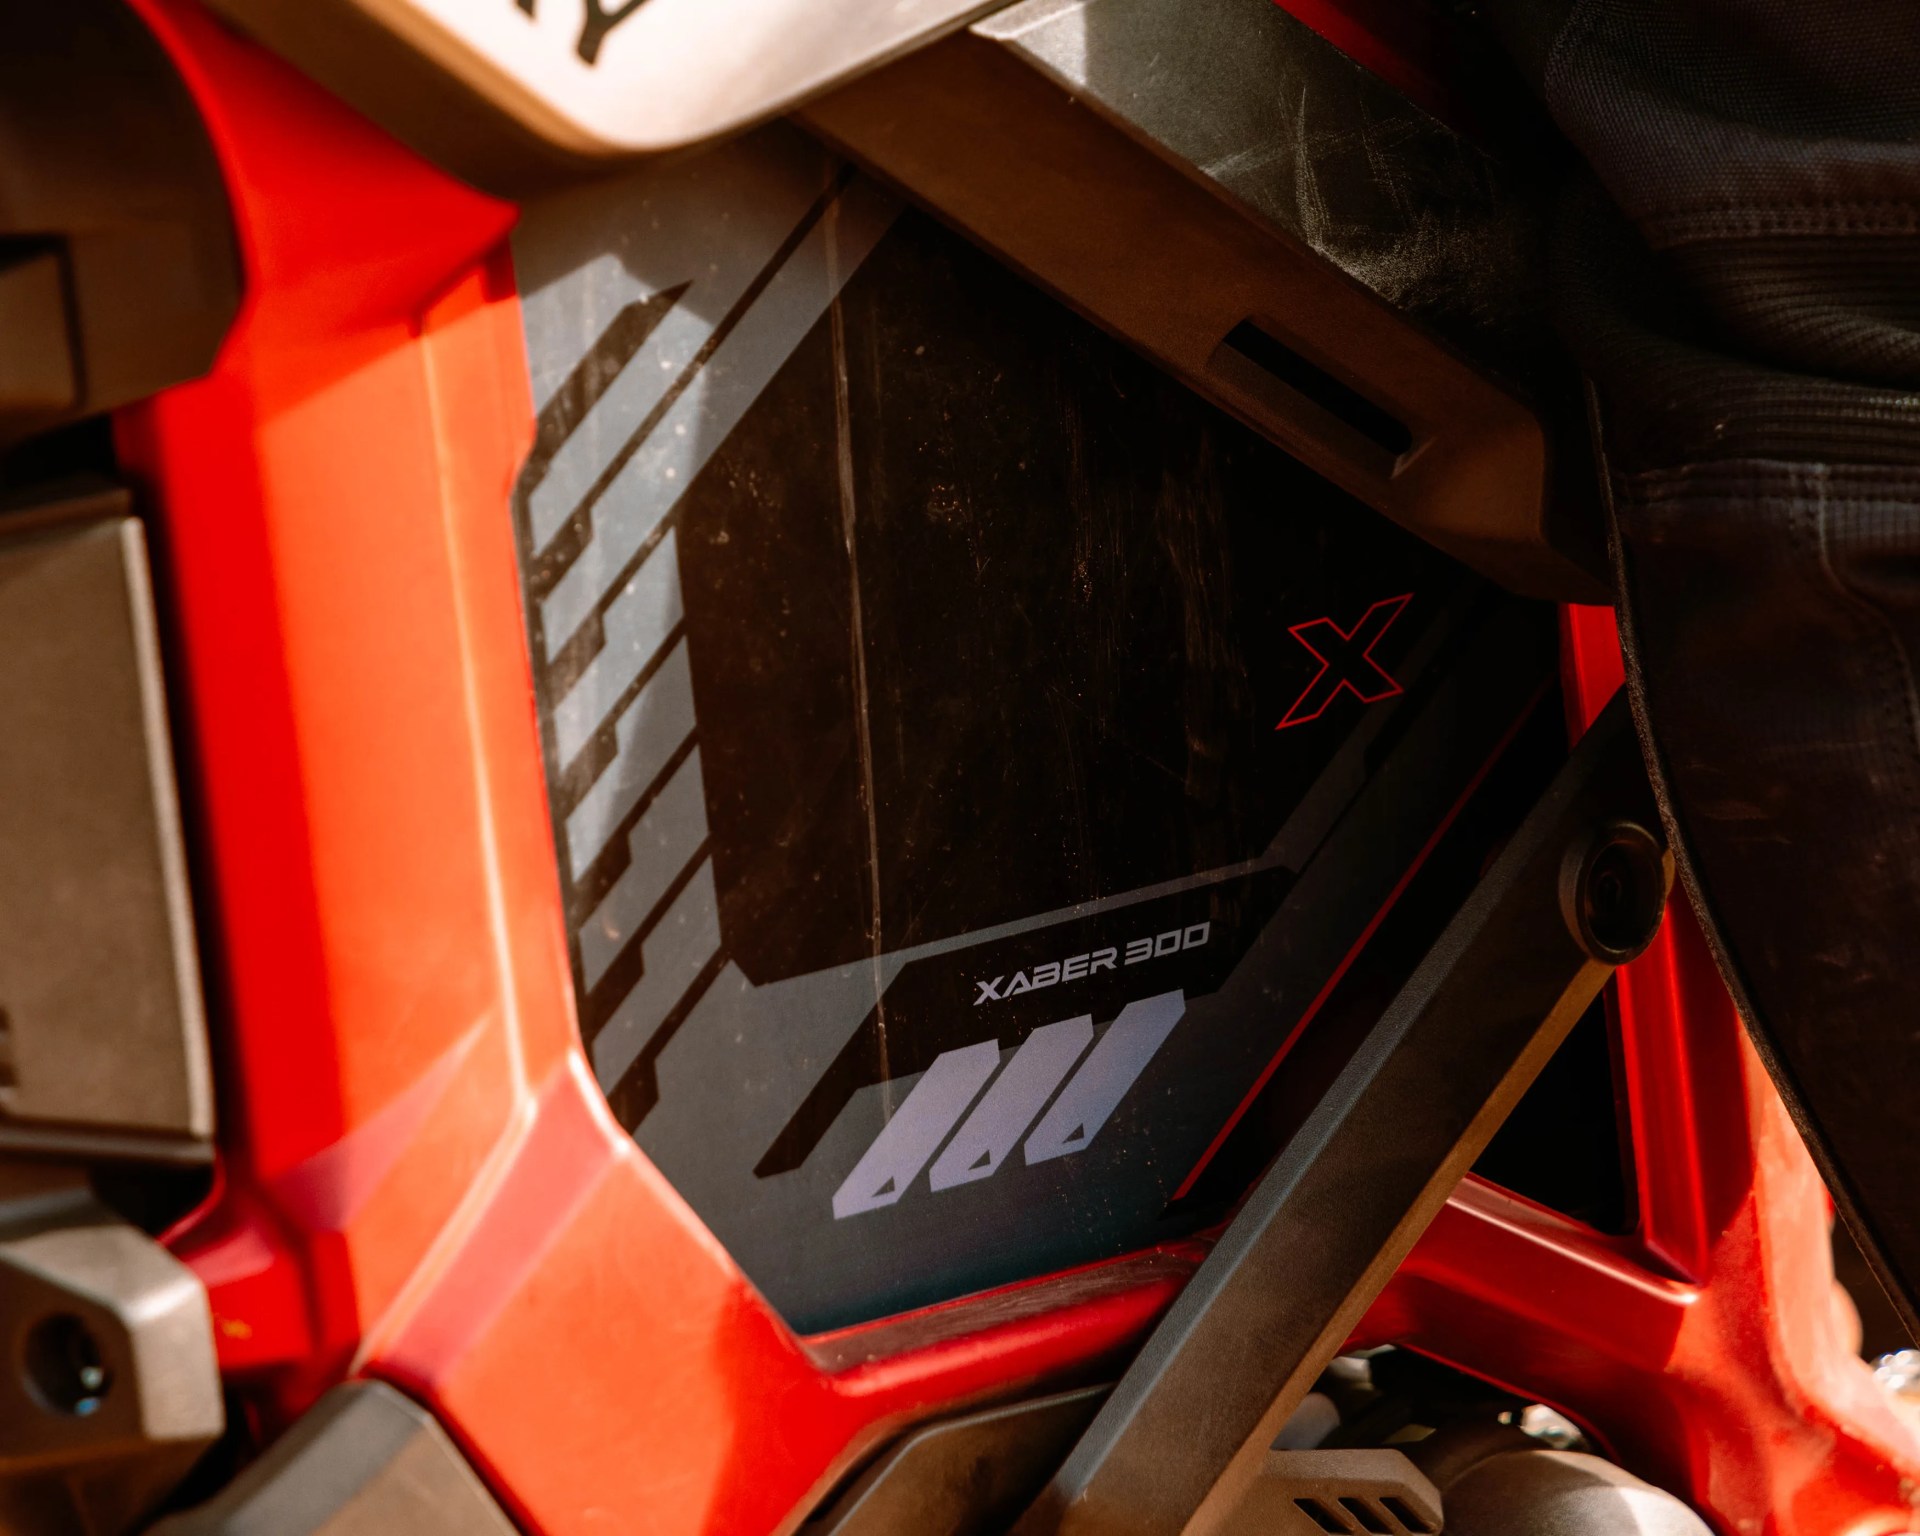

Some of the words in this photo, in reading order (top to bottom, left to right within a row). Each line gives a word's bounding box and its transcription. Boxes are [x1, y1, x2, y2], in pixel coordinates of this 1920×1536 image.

[1275, 592, 1414, 730] X
[973, 946, 1118, 1006] XABER
[1124, 921, 1211, 966] 300
